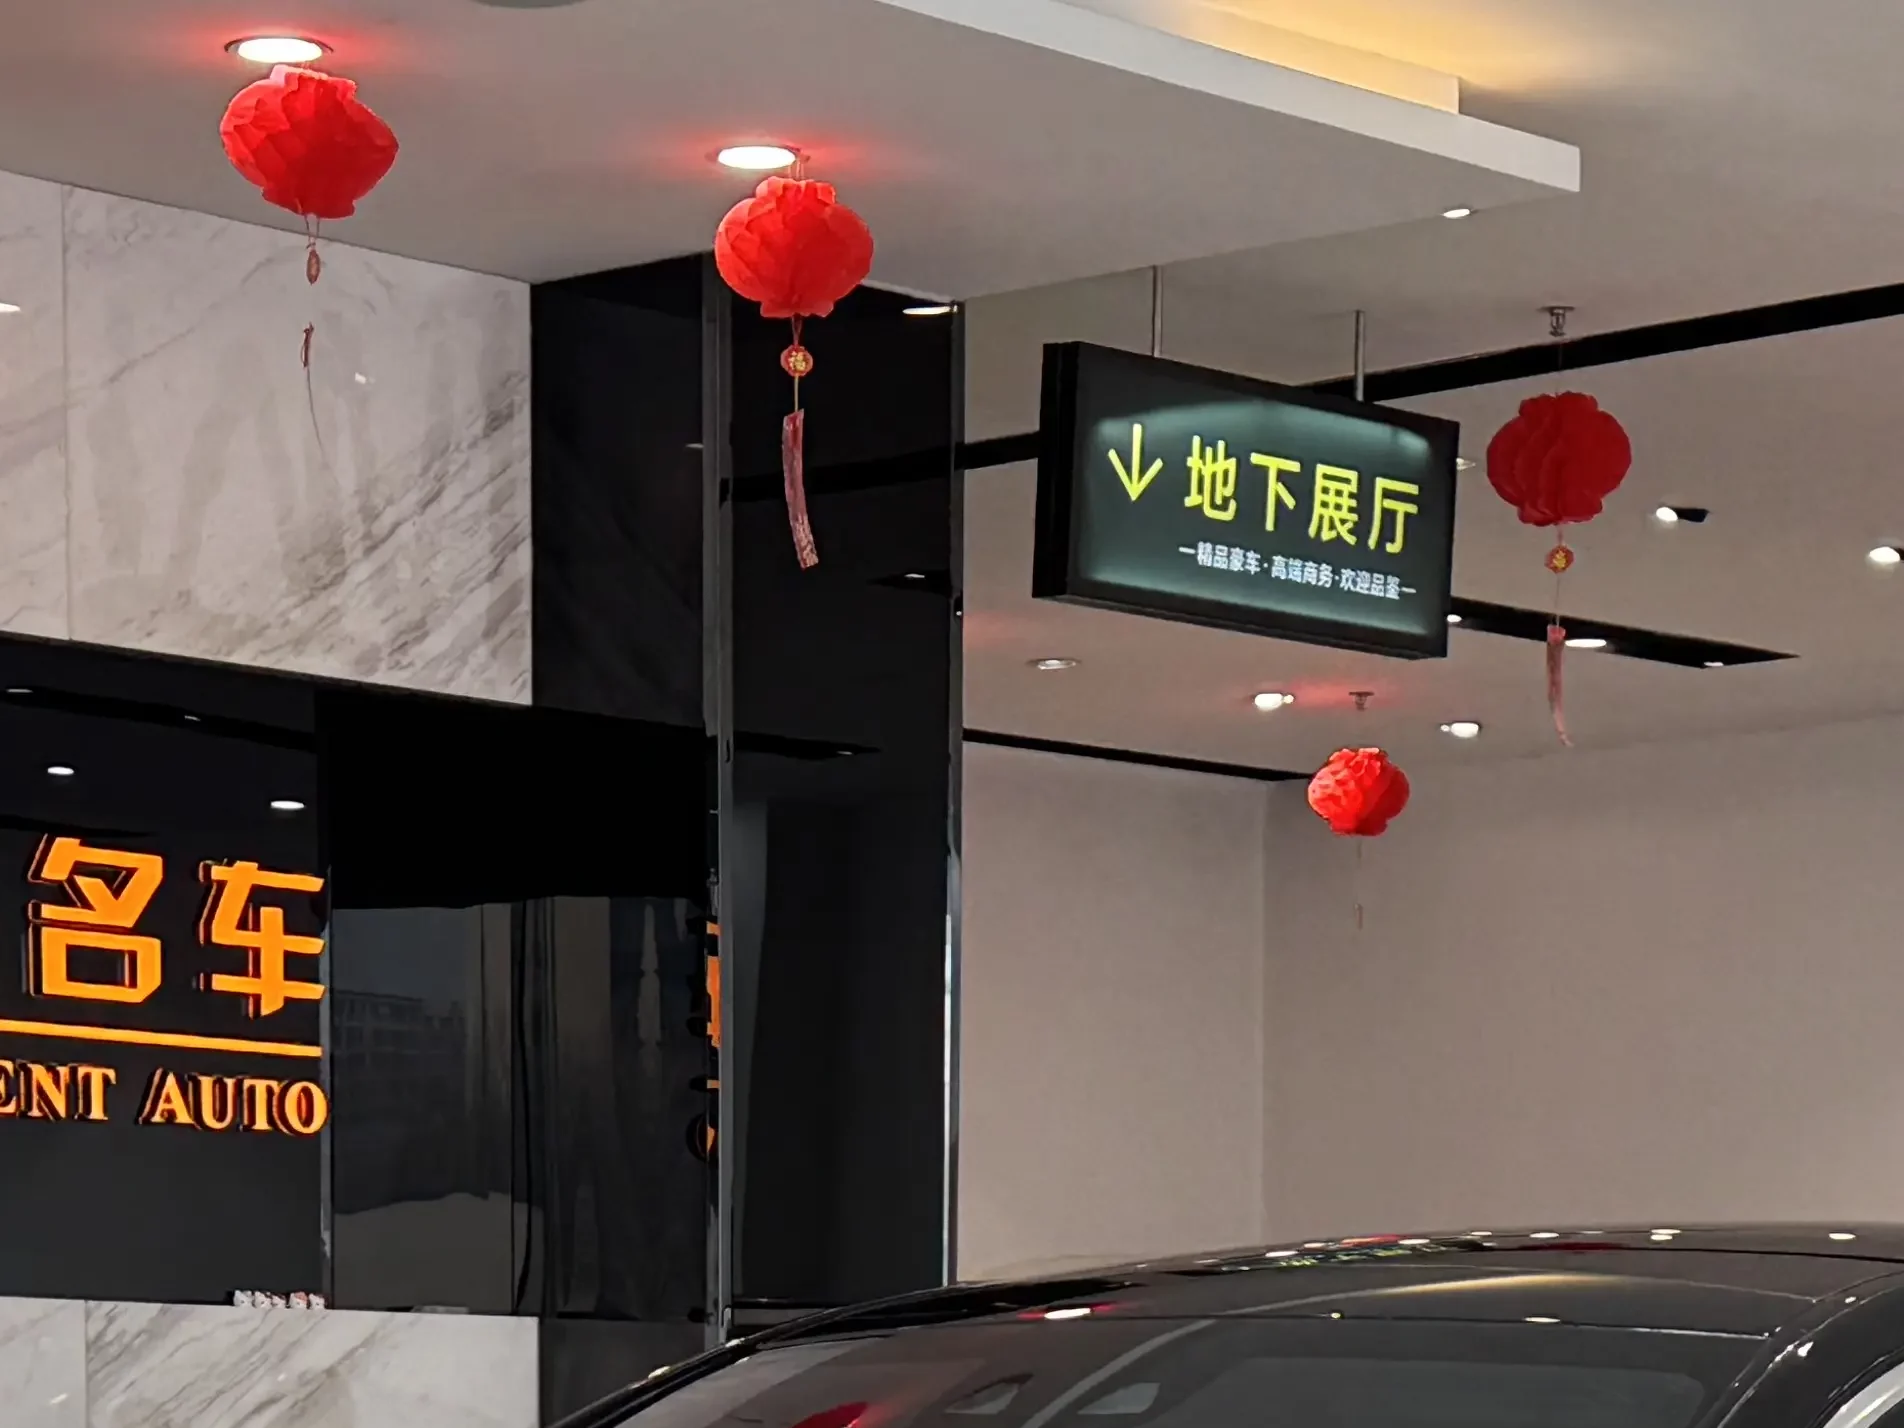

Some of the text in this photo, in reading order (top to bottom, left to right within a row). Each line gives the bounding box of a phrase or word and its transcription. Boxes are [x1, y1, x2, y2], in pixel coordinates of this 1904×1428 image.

[1184, 435, 1420, 554] 地下展厅
[149, 1070, 329, 1135] AUTO
